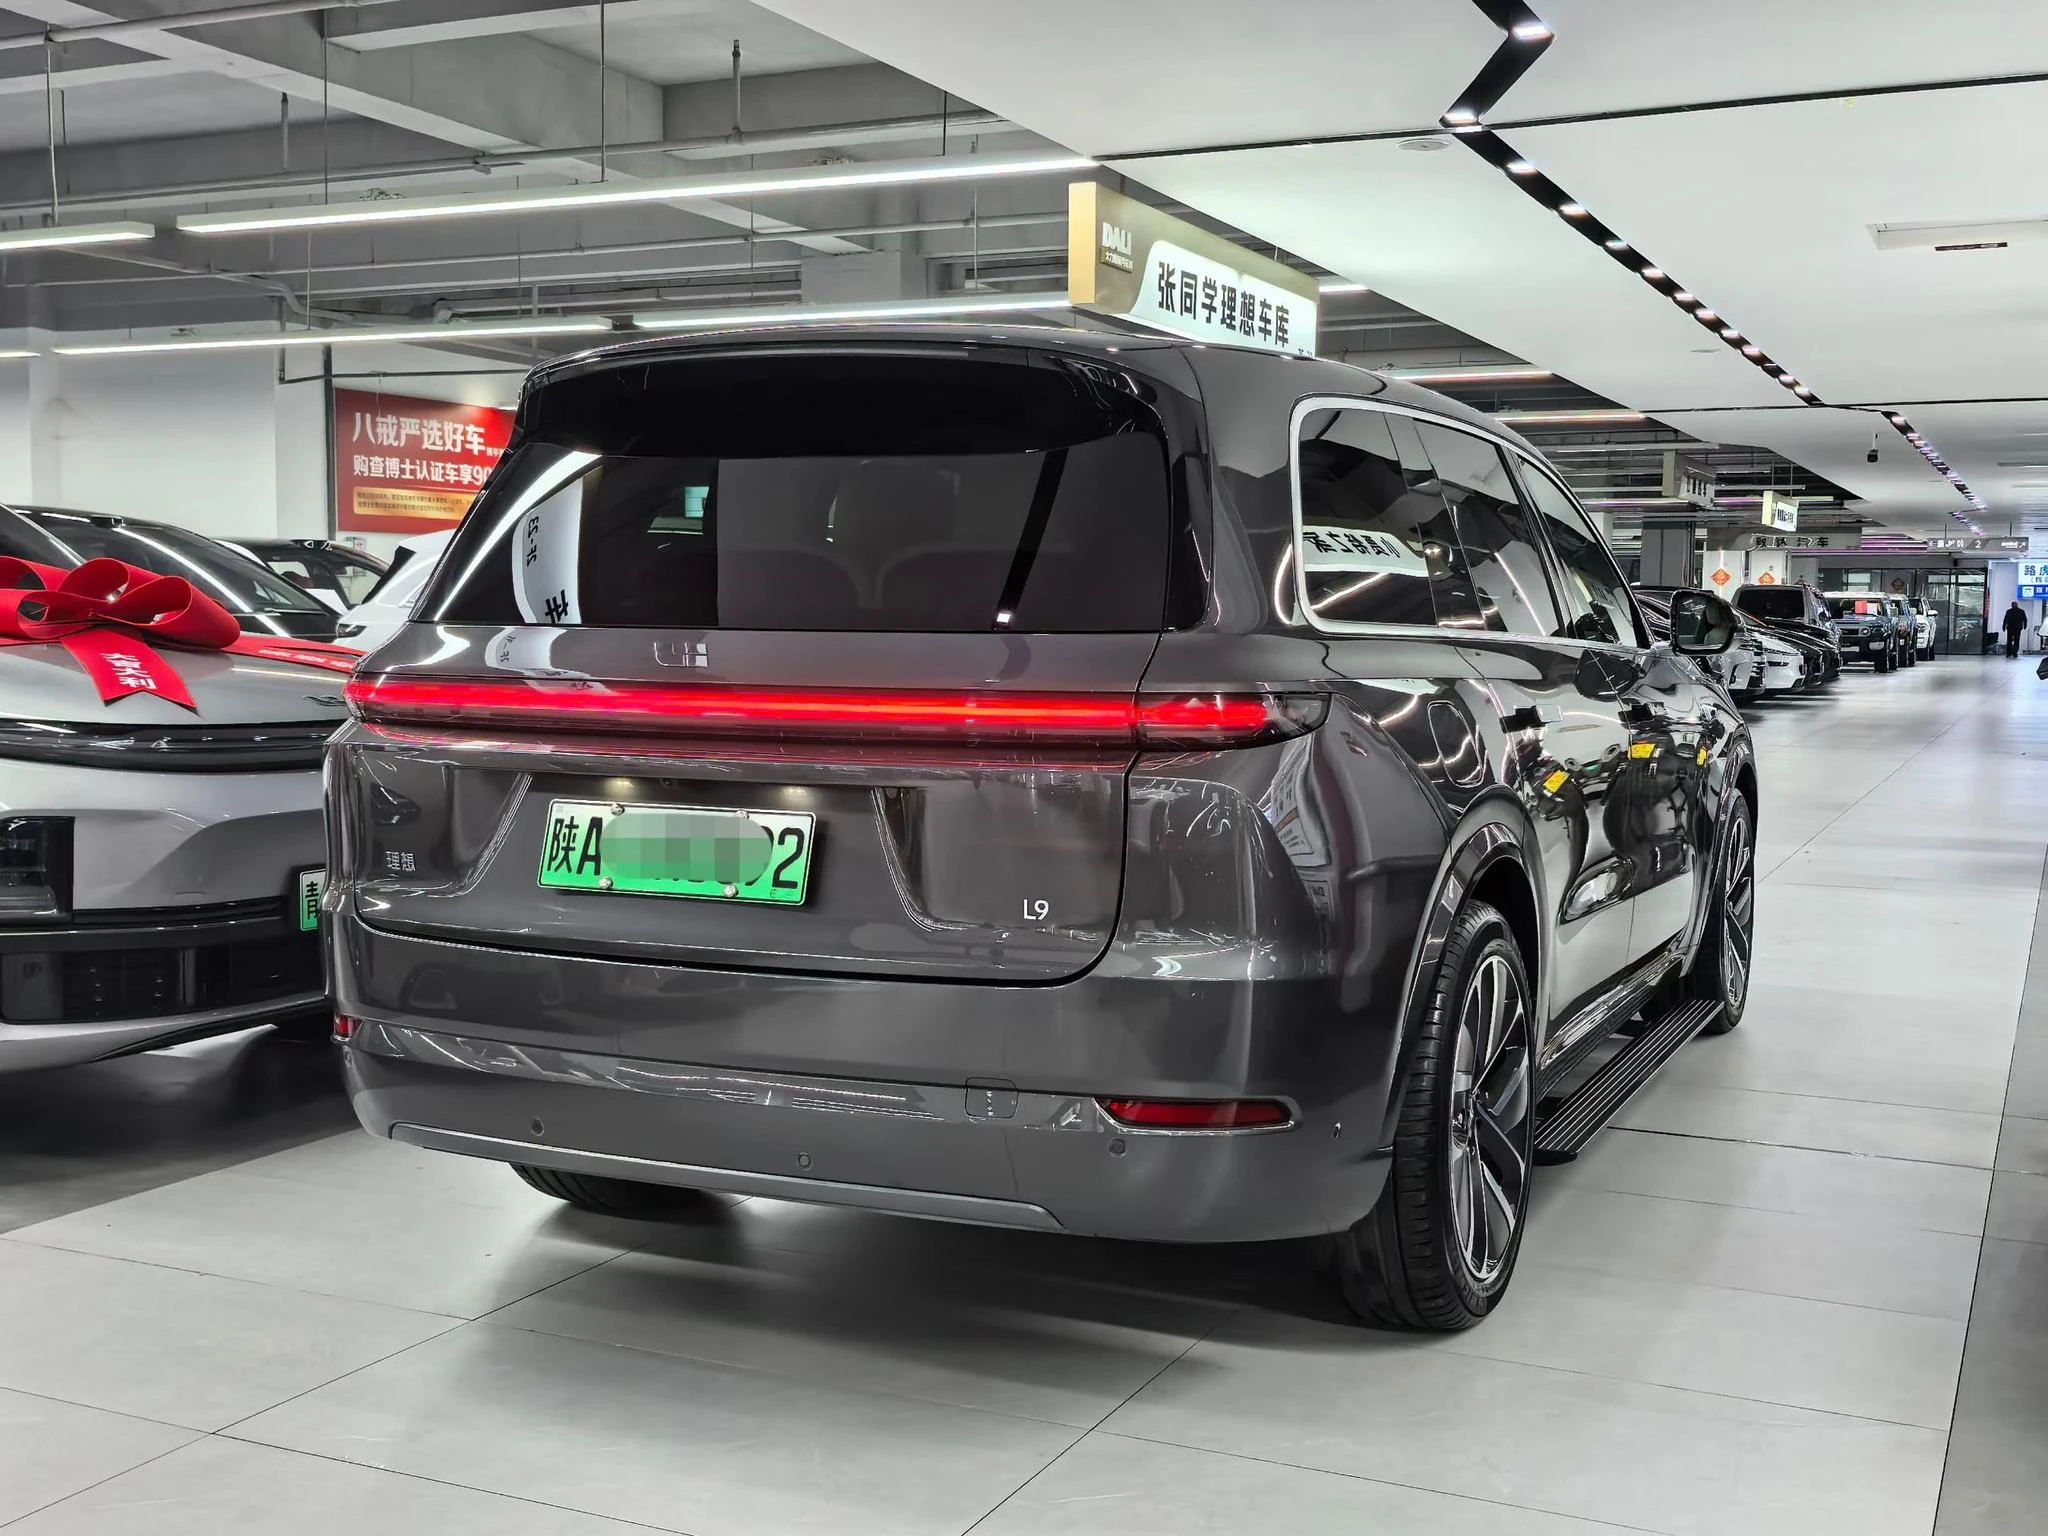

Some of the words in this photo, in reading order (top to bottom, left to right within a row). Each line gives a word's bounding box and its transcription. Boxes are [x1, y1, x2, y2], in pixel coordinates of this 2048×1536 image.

[1158, 261, 1289, 347] 张同学理想车库
[352, 411, 486, 456] 八戒严选好车
[99, 652, 158, 690] 大吉大利
[1023, 899, 1049, 921] L9
